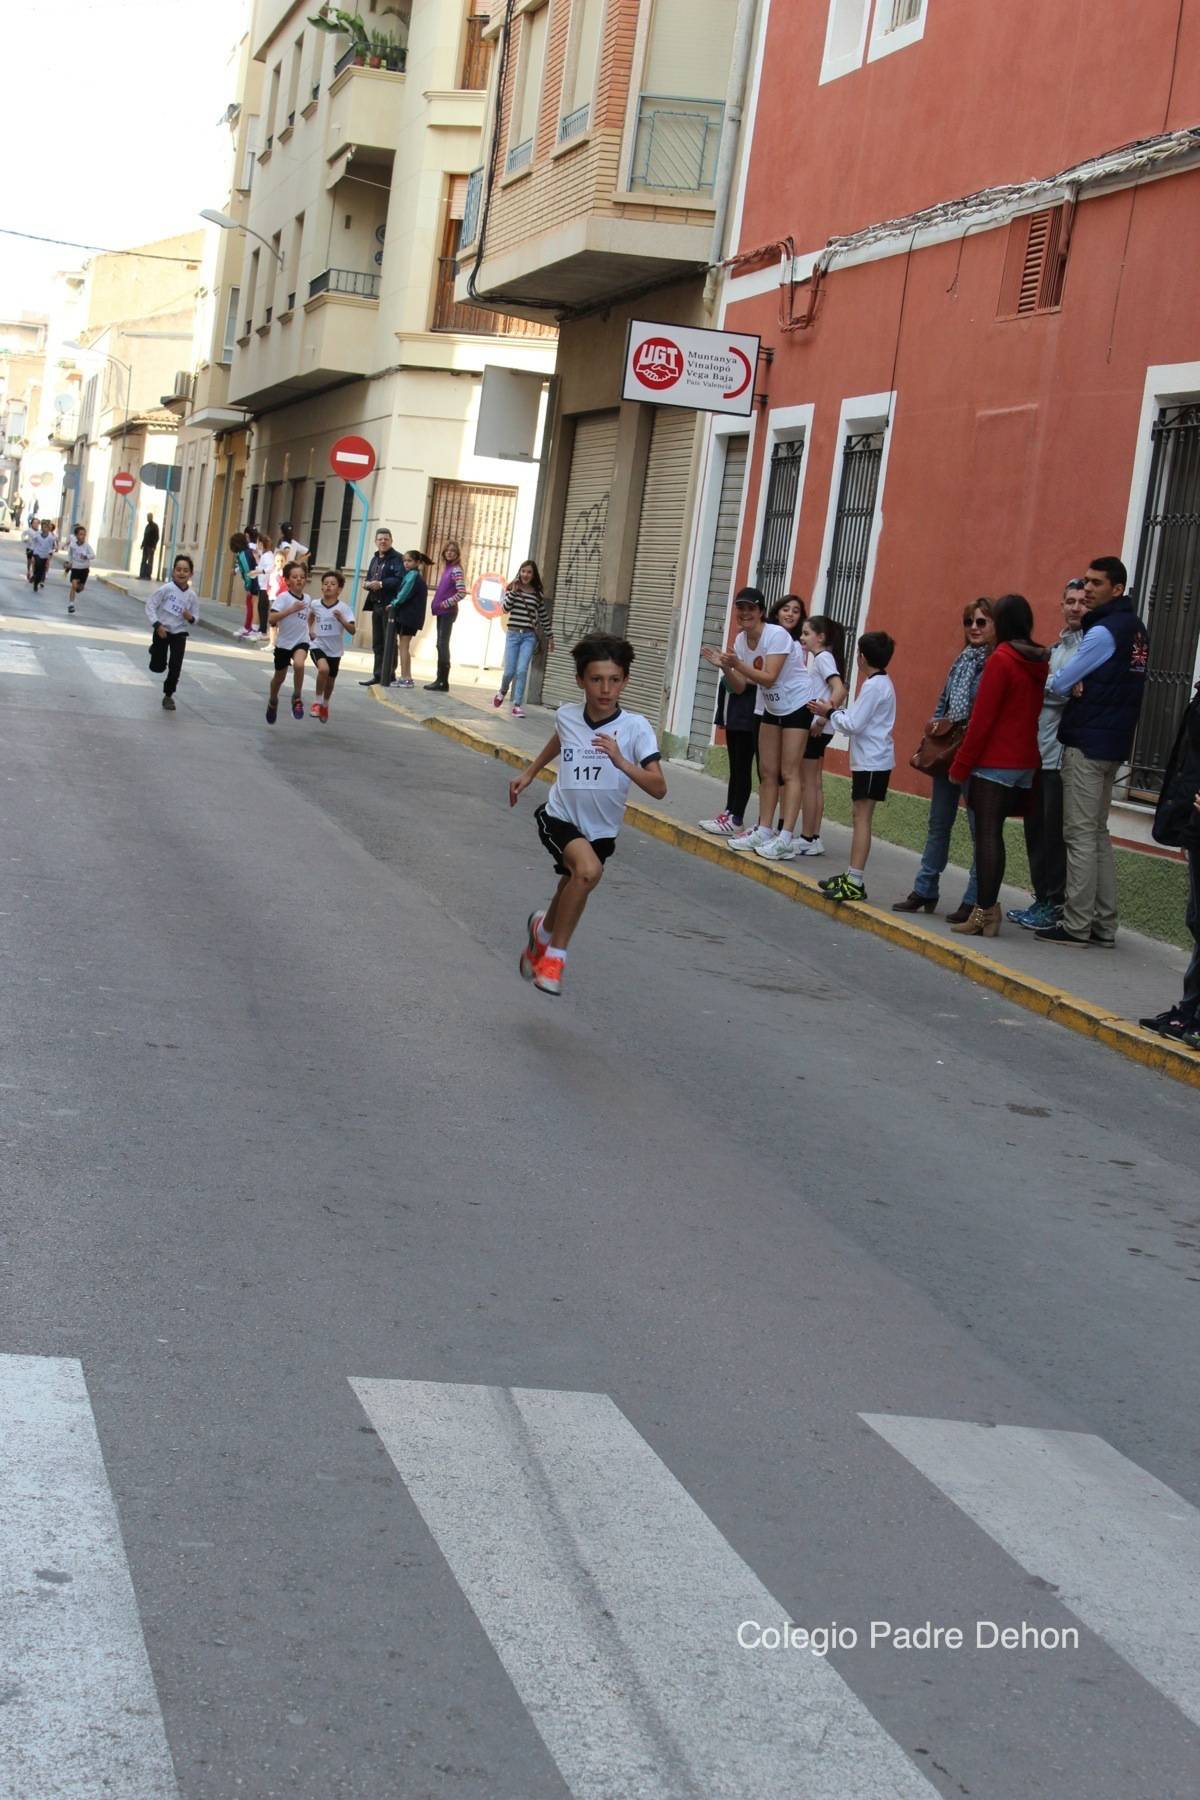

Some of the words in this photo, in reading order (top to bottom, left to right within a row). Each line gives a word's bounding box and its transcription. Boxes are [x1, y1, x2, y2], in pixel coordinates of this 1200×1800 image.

[639, 344, 678, 368] UGT
[688, 351, 737, 364] Muntanya
[687, 360, 731, 373] Vinalopó
[686, 369, 709, 380] Vega
[712, 373, 734, 382] Baja
[573, 766, 602, 781] 117
